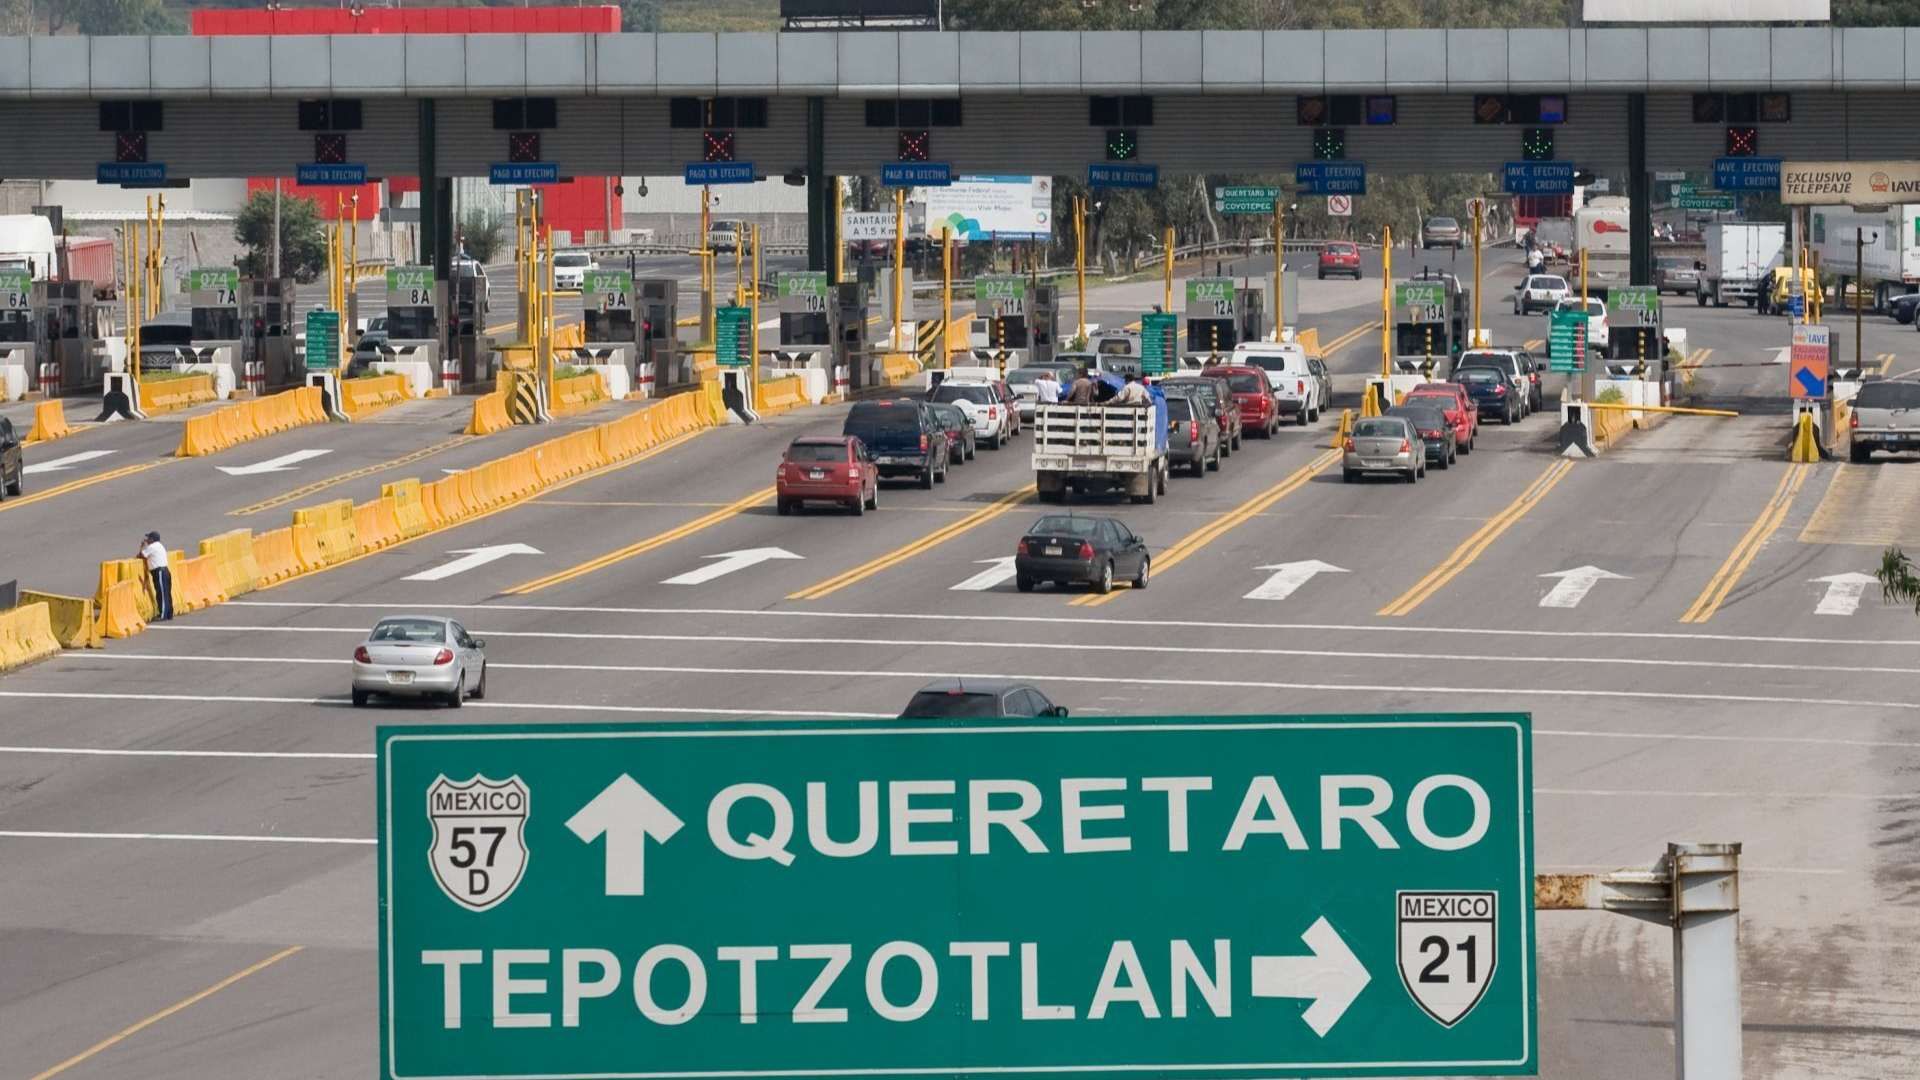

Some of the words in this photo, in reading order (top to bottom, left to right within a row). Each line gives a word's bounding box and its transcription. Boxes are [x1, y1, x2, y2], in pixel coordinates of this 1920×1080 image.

[300, 170, 317, 180] PAGO
[320, 170, 329, 180] EN
[332, 170, 362, 180] EFECTIVO
[493, 168, 510, 179] PAGO
[513, 168, 521, 178] EN
[524, 168, 555, 178] EFECTIVO
[689, 169, 706, 178] PAGO
[709, 168, 718, 178] EN
[720, 167, 750, 178] EFECTIVO
[885, 170, 901, 180] PAGO
[1533, 167, 1570, 177] EFECTIVO
[1786, 171, 1852, 184] EXCLUSIVO
[1535, 180, 1568, 190] CREDITO
[1787, 183, 1852, 194] TELEPEAJE
[1225, 189, 1265, 197] QUERETARO
[853, 226, 860, 235] A
[200, 273, 228, 286] 074
[396, 272, 424, 285] 074
[593, 275, 621, 288] 074
[789, 277, 817, 290] 074
[986, 281, 1014, 294] 074
[1196, 283, 1224, 296] 074
[1406, 286, 1434, 300] 074
[1619, 292, 1646, 305] 074
[436, 792, 522, 811] MEXICO
[706, 773, 1491, 867] QUERETARO
[449, 826, 507, 869] 57
[468, 868, 490, 896] D
[1404, 898, 1489, 917] MEXICO
[1418, 935, 1477, 984] 21
[421, 939, 1232, 1029] TEPOTZOTLAN
